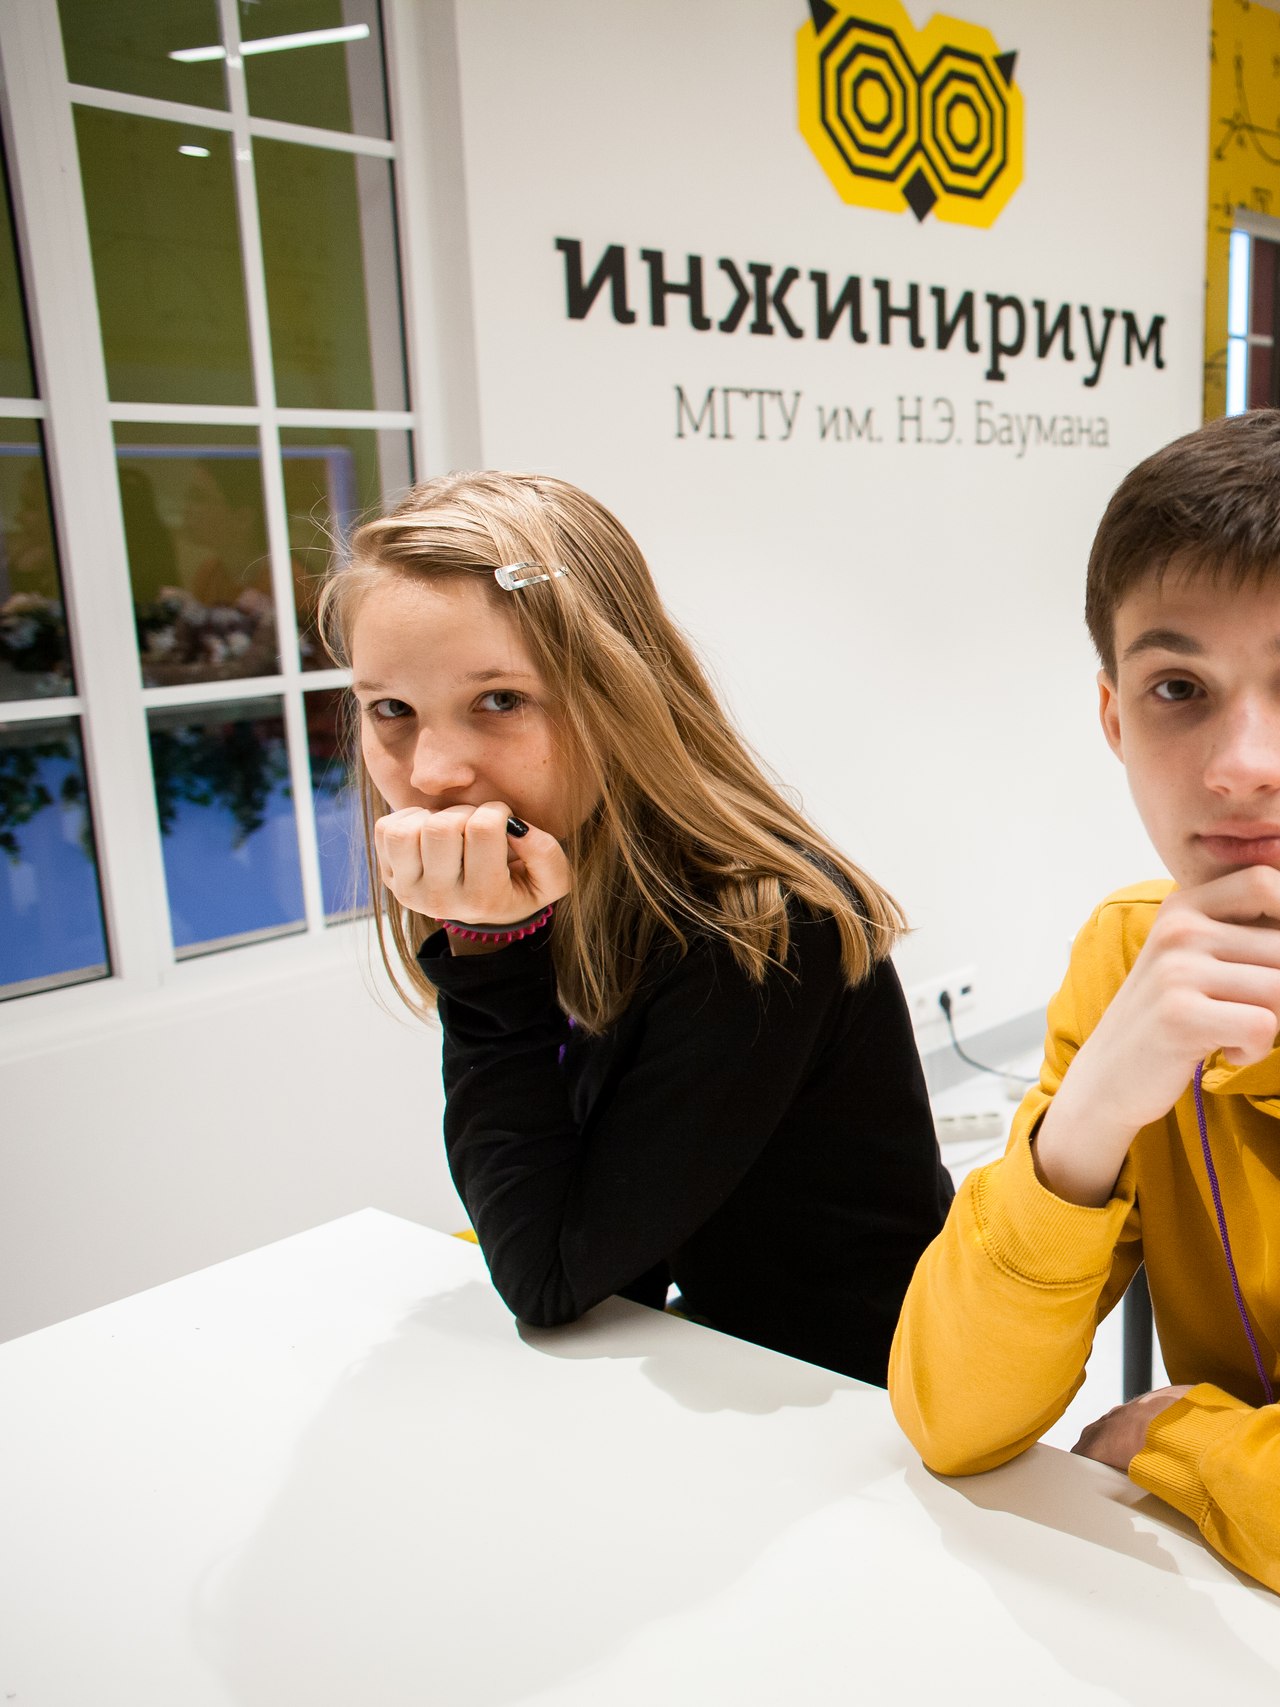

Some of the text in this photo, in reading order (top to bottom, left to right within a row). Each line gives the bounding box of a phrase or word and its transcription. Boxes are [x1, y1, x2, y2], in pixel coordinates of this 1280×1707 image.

[674, 385, 1110, 458] МГТУ им. Н.Э. Баумана
